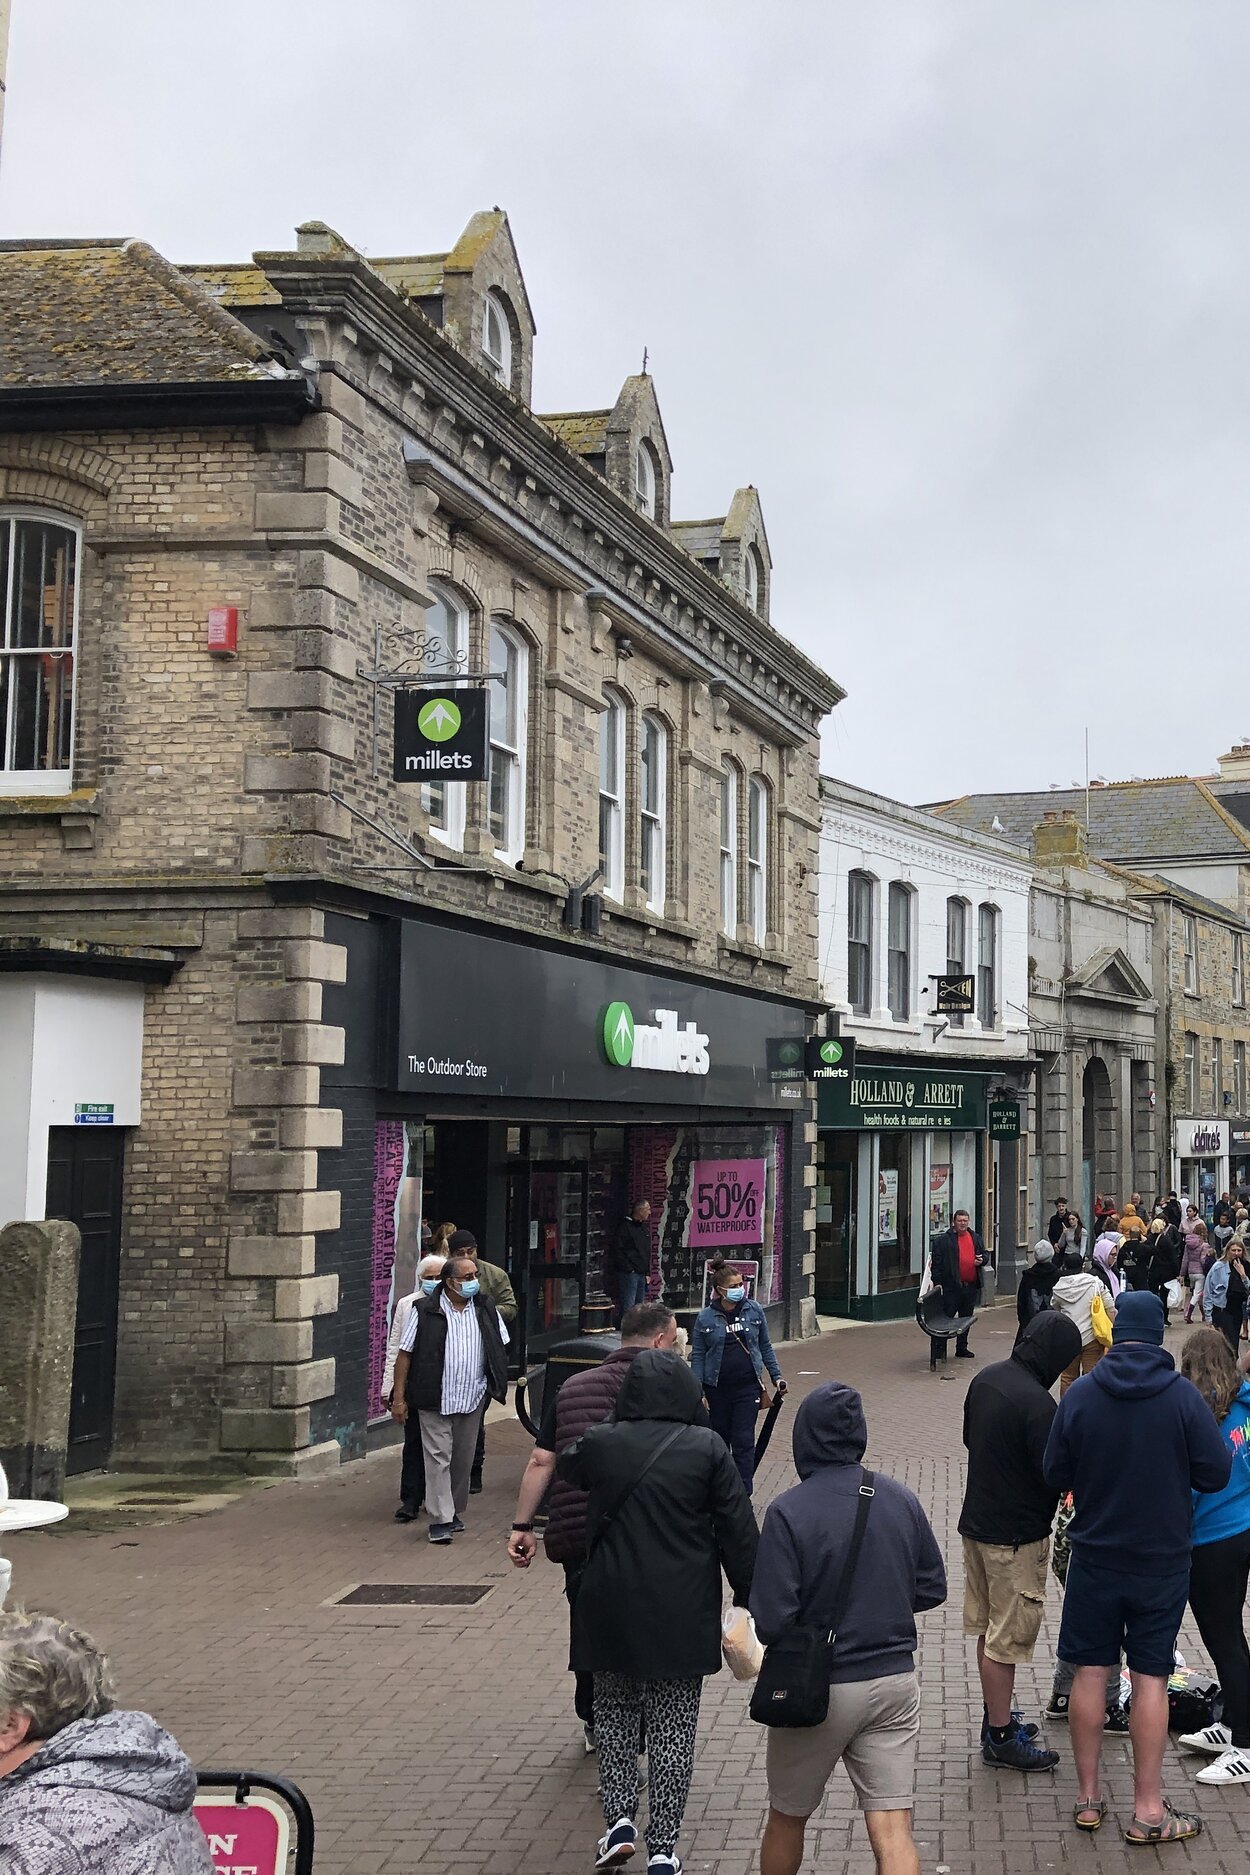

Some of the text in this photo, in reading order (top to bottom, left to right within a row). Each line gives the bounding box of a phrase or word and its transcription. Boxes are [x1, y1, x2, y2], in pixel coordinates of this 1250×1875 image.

[405, 750, 473, 770] millets
[631, 1008, 710, 1075] millets
[408, 1055, 487, 1077] The Outdoor Store
[813, 1066, 849, 1078] millets
[850, 1079, 903, 1106] HOLLAND
[905, 1081, 915, 1107] &
[863, 1113, 882, 1125] health
[883, 1113, 900, 1125] foods
[908, 1114, 928, 1125] natural
[717, 1171, 738, 1182] UP TO
[698, 1182, 756, 1220] 50%
[697, 1220, 757, 1233] WATERPROOFS
